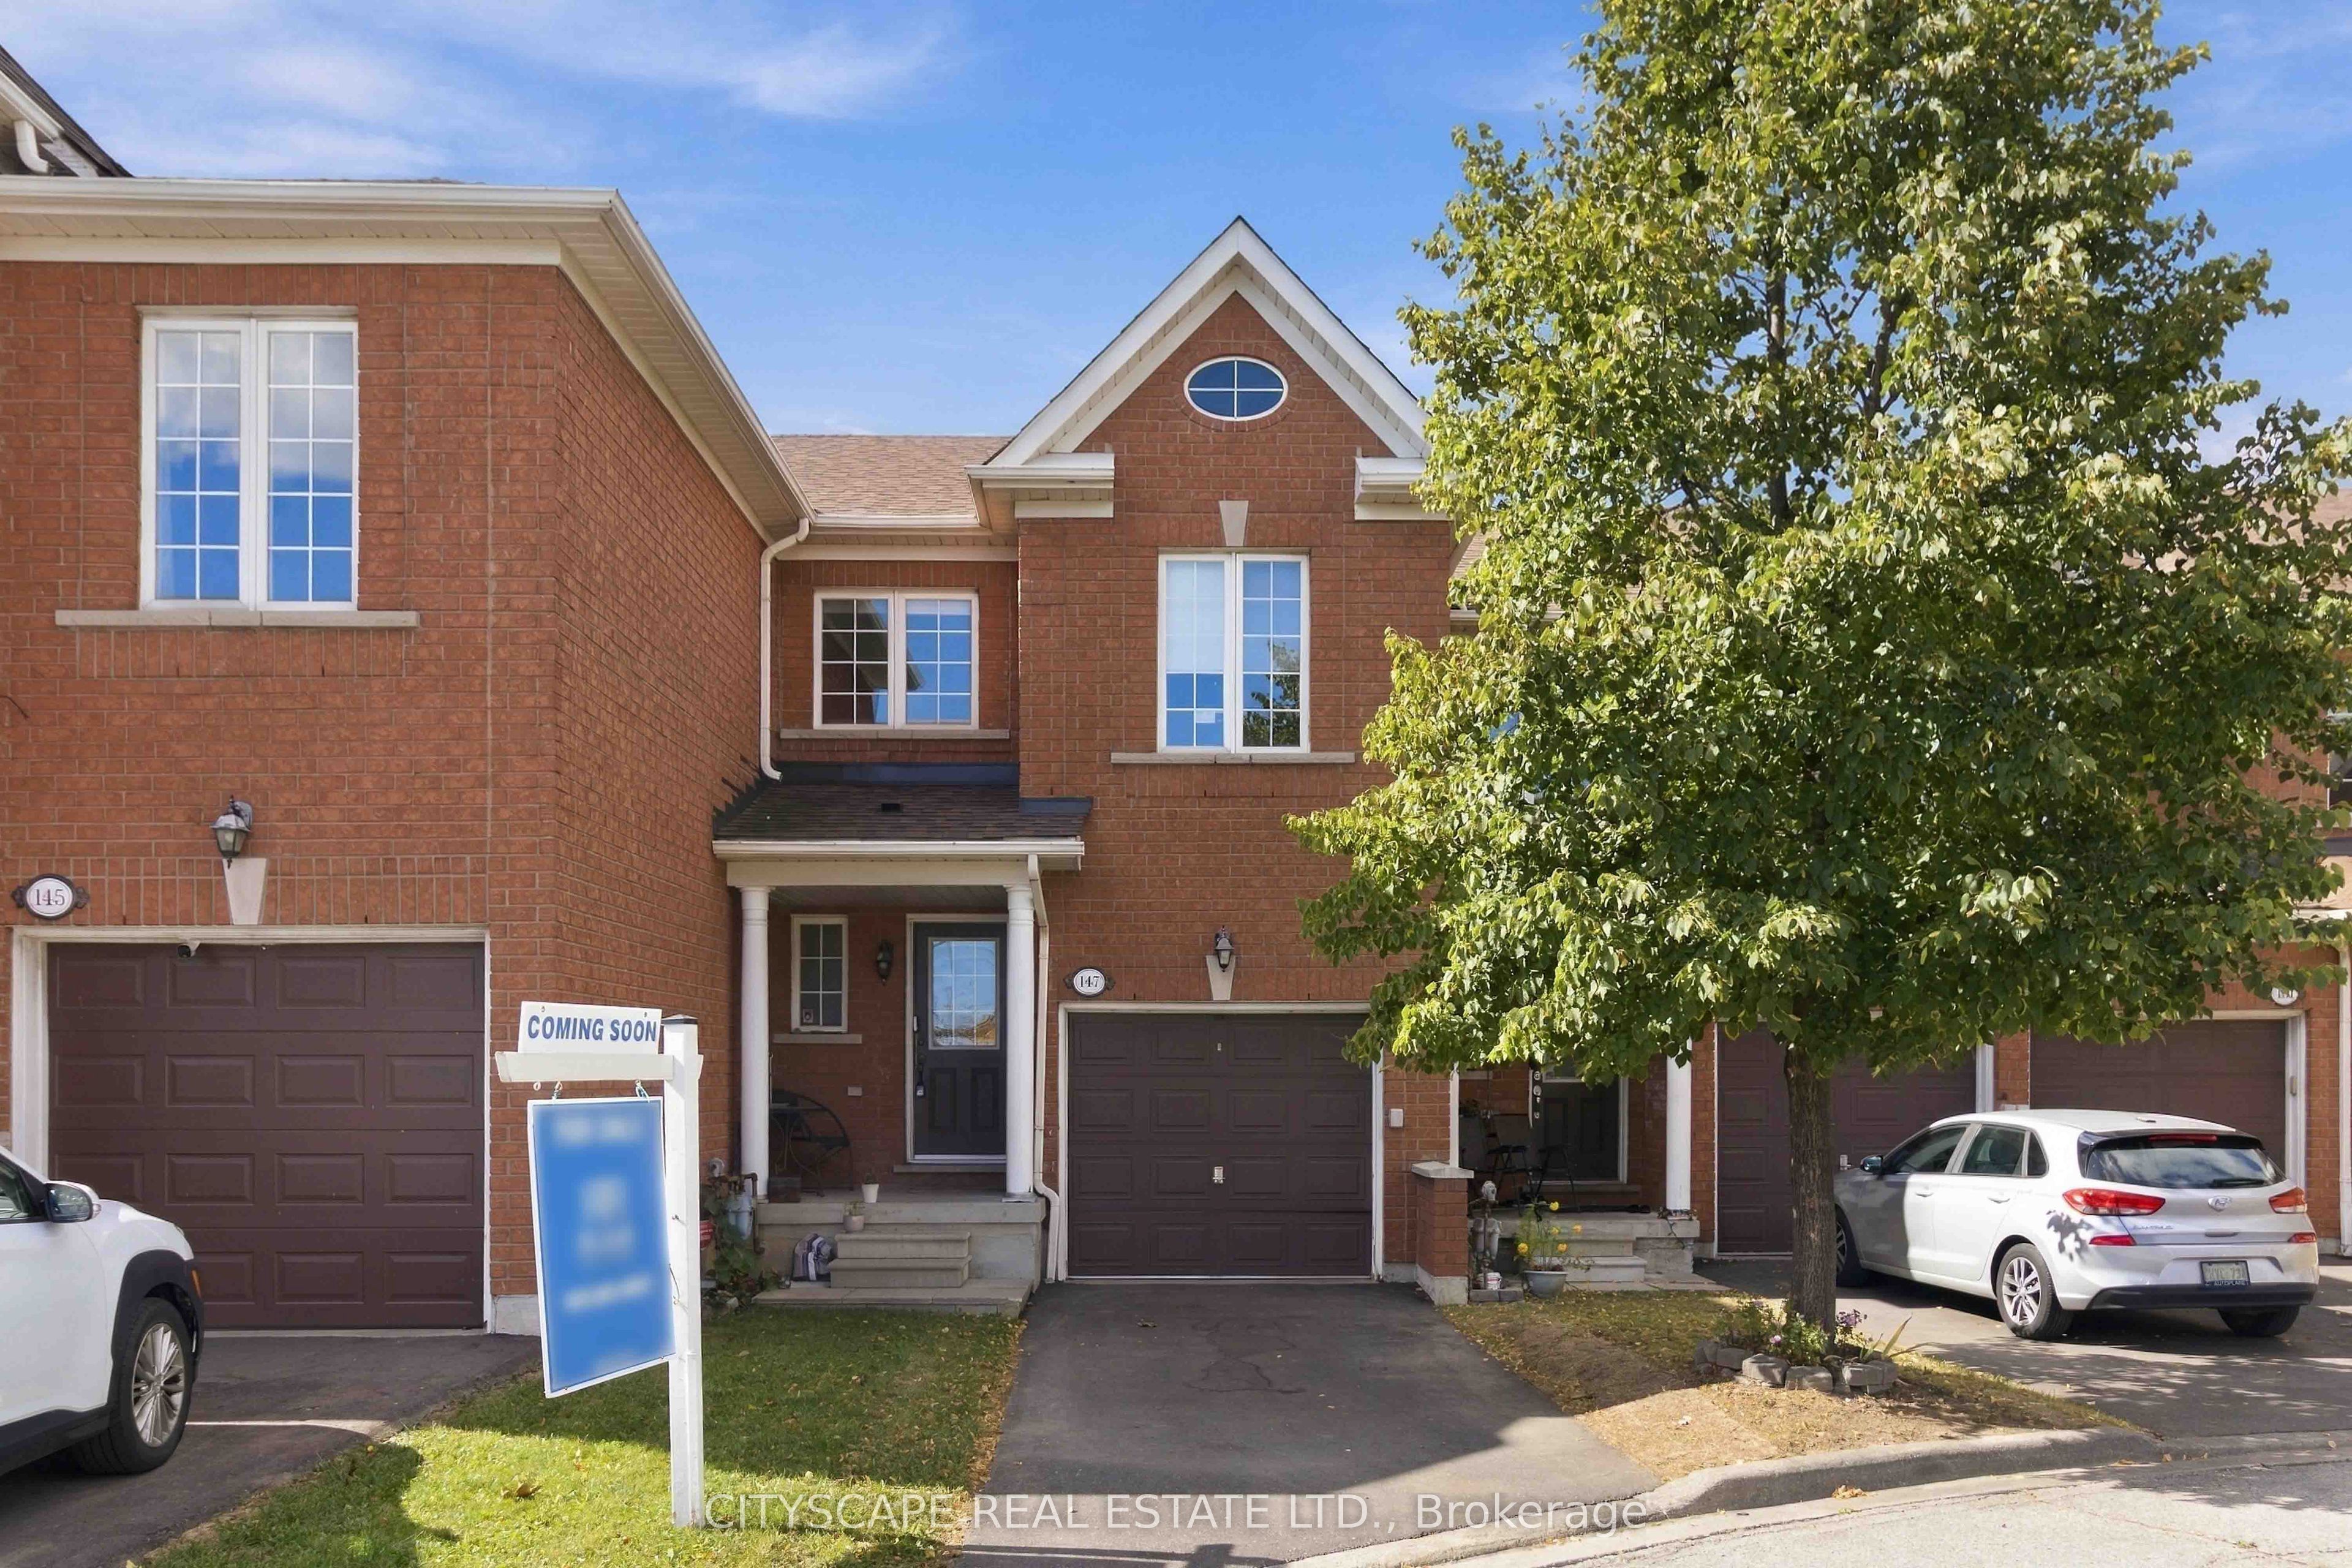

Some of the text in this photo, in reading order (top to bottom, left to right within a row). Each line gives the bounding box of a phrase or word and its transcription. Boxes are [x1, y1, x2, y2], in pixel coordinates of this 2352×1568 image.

[34, 889, 65, 906] 145
[1079, 975, 1100, 988] 147
[527, 1014, 657, 1042] COMING SOON
